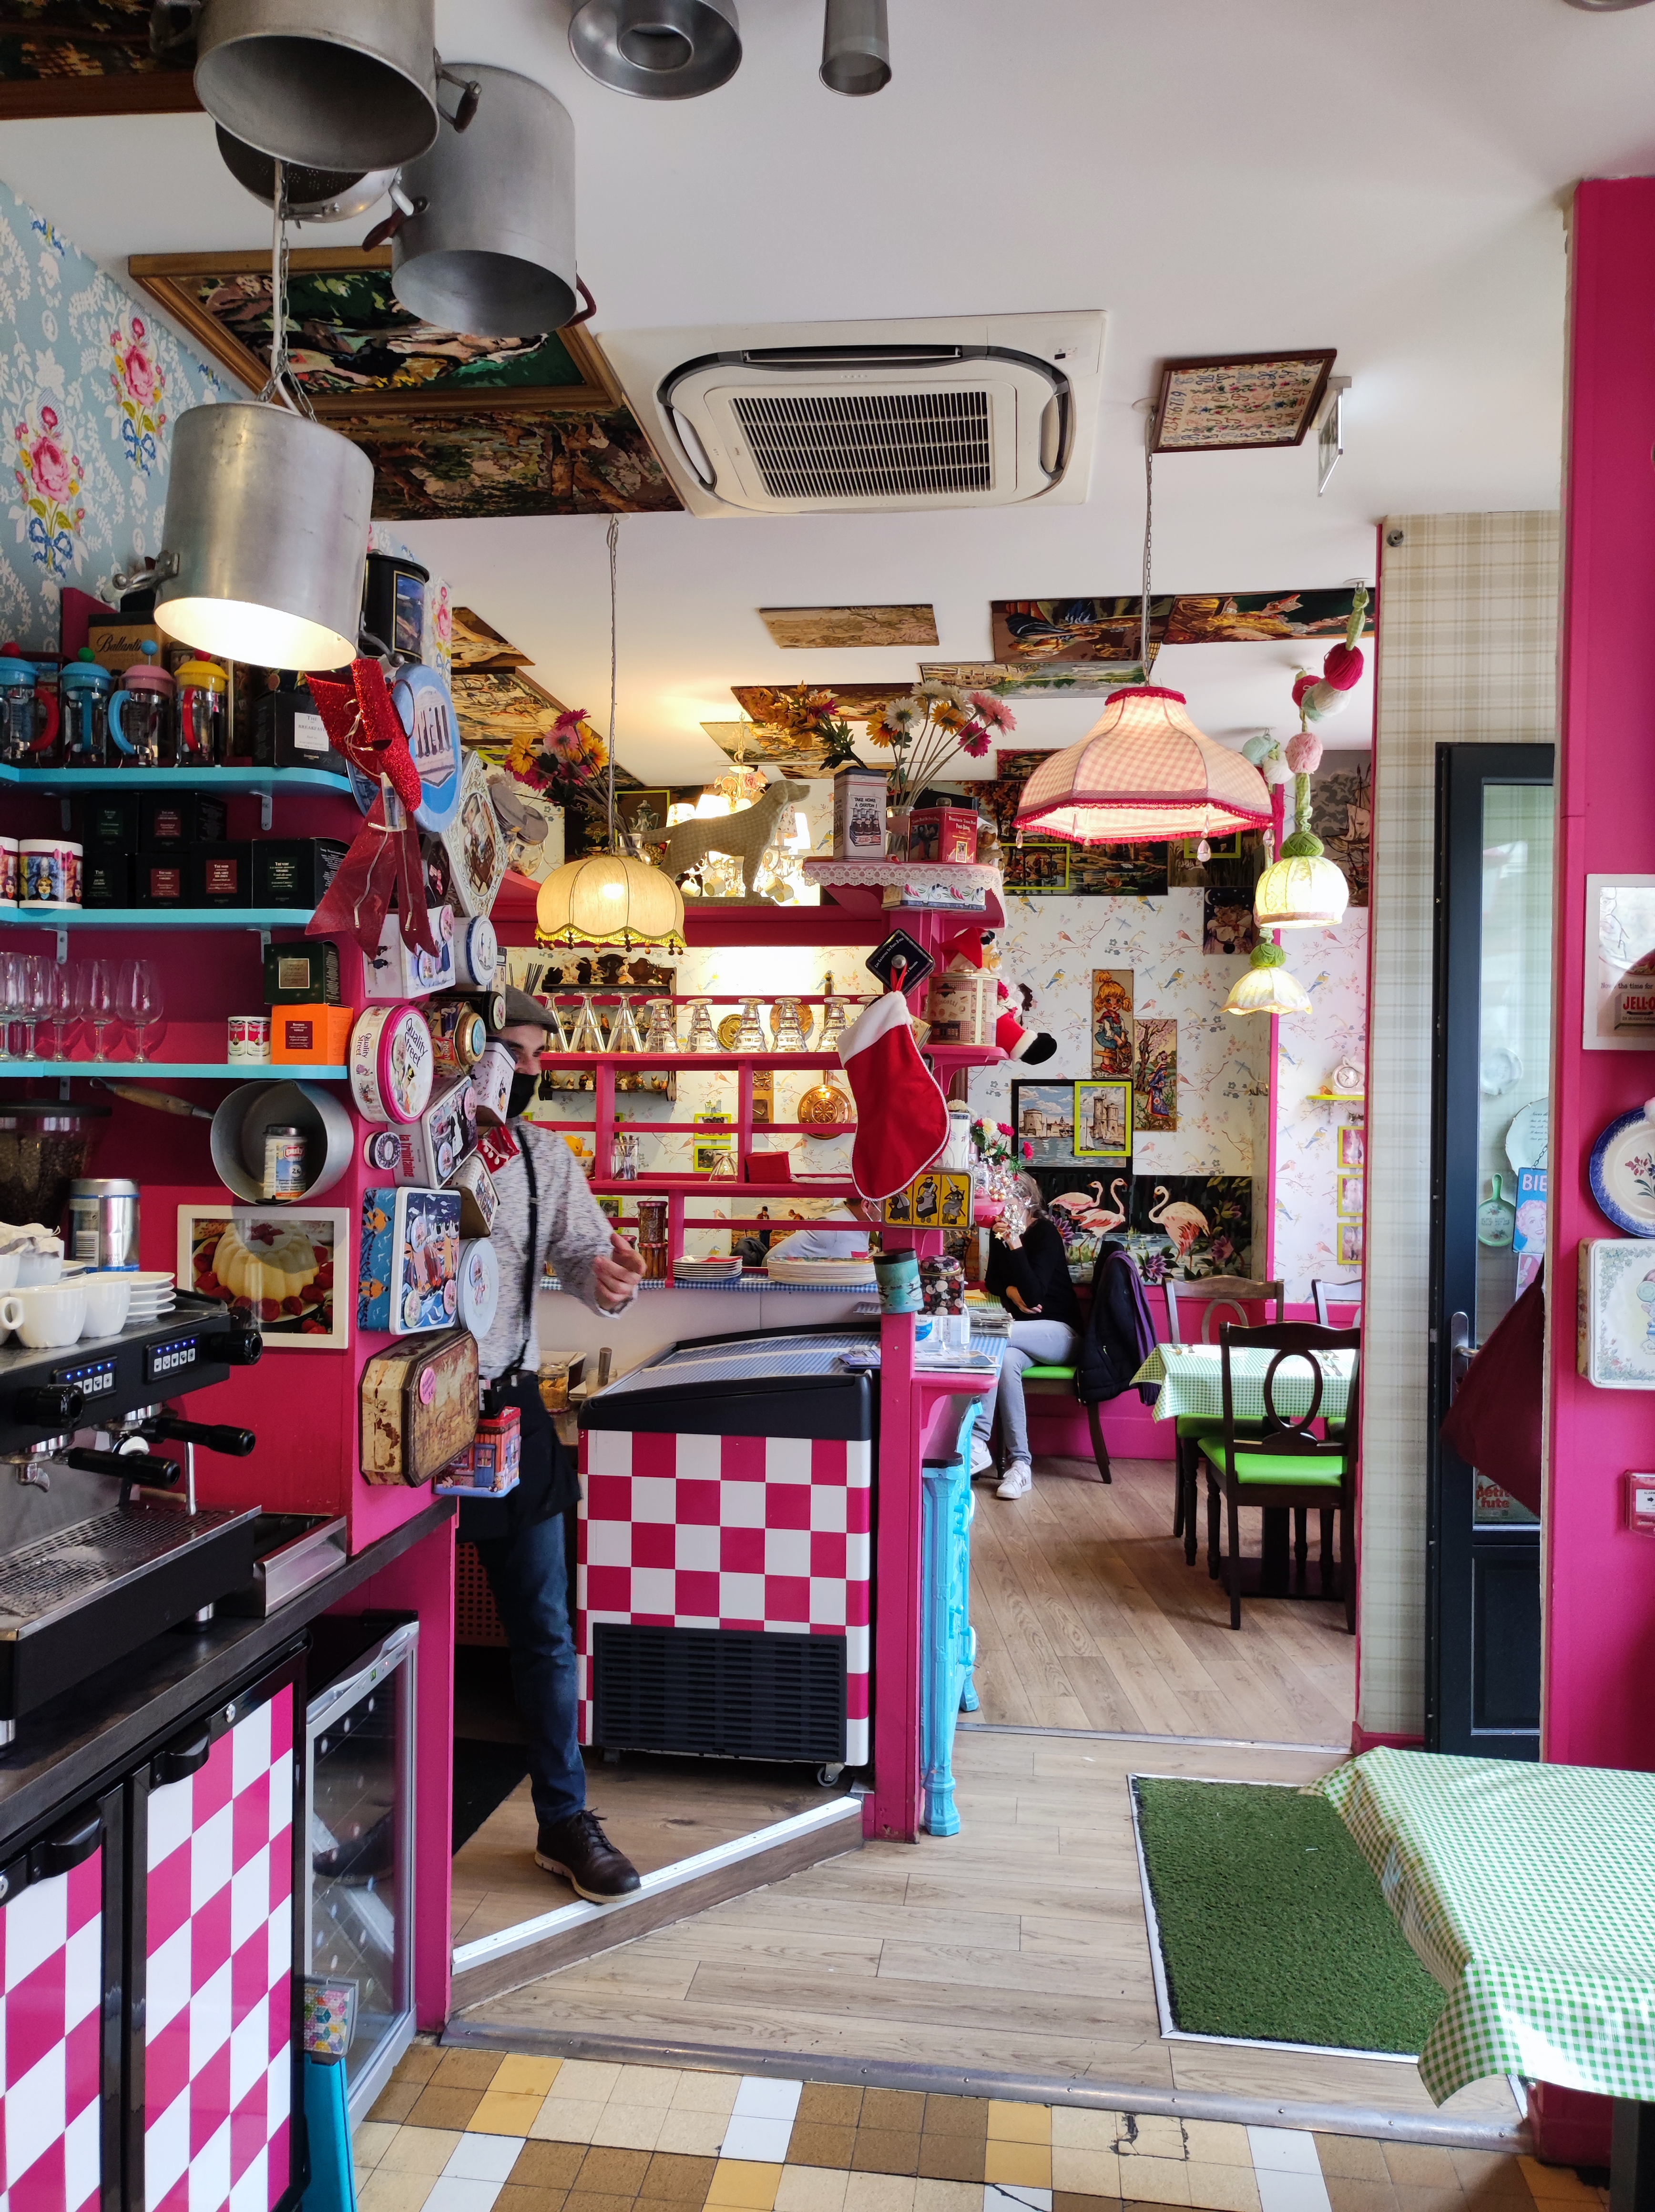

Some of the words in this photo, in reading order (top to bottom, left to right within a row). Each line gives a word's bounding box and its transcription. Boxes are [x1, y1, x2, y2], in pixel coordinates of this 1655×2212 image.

[356, 1034, 365, 1057] Street
[361, 1033, 372, 1058] Quality
[404, 1032, 421, 1068] Street
[406, 1017, 429, 1058] Quality
[401, 1143, 416, 1178] trinitaine
